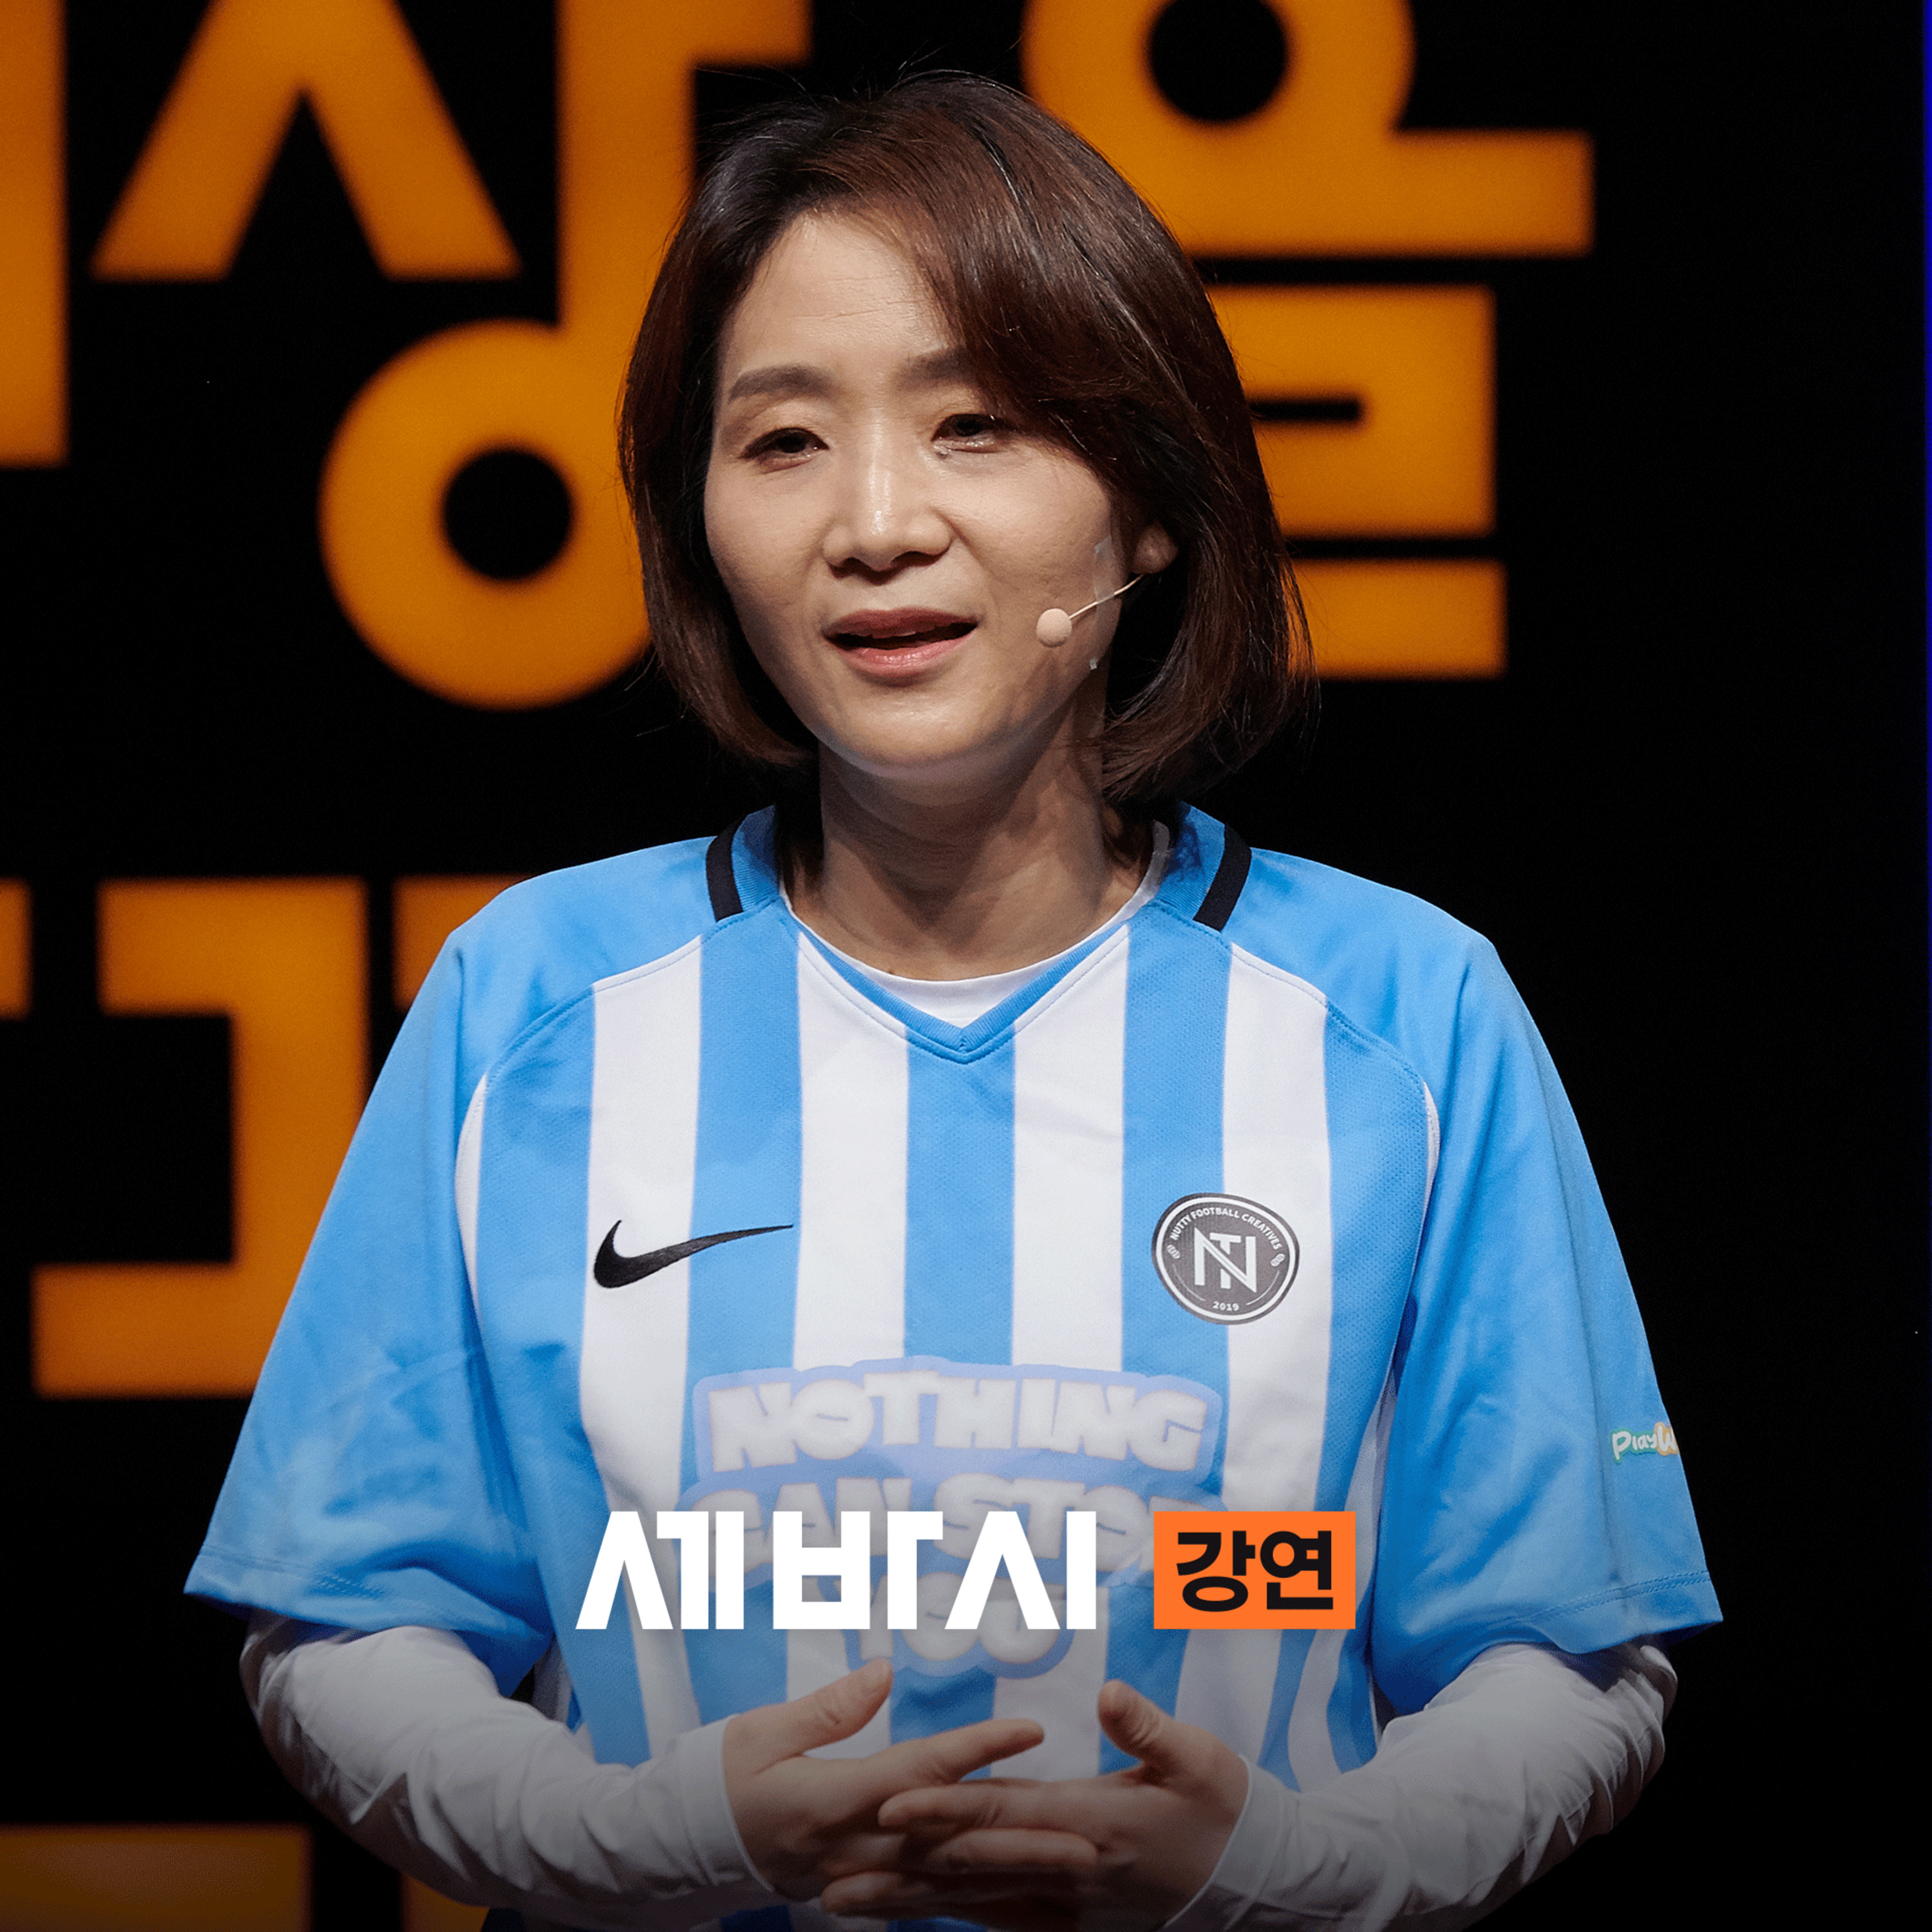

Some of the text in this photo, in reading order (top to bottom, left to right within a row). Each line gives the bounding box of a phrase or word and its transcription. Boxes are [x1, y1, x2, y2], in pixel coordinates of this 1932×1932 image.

[1170, 1207, 1283, 1250] NUTTY FOOTBALL CREATIVES
[1213, 1301, 1240, 1311] 2019
[708, 1369, 1208, 1473] NOTHING
